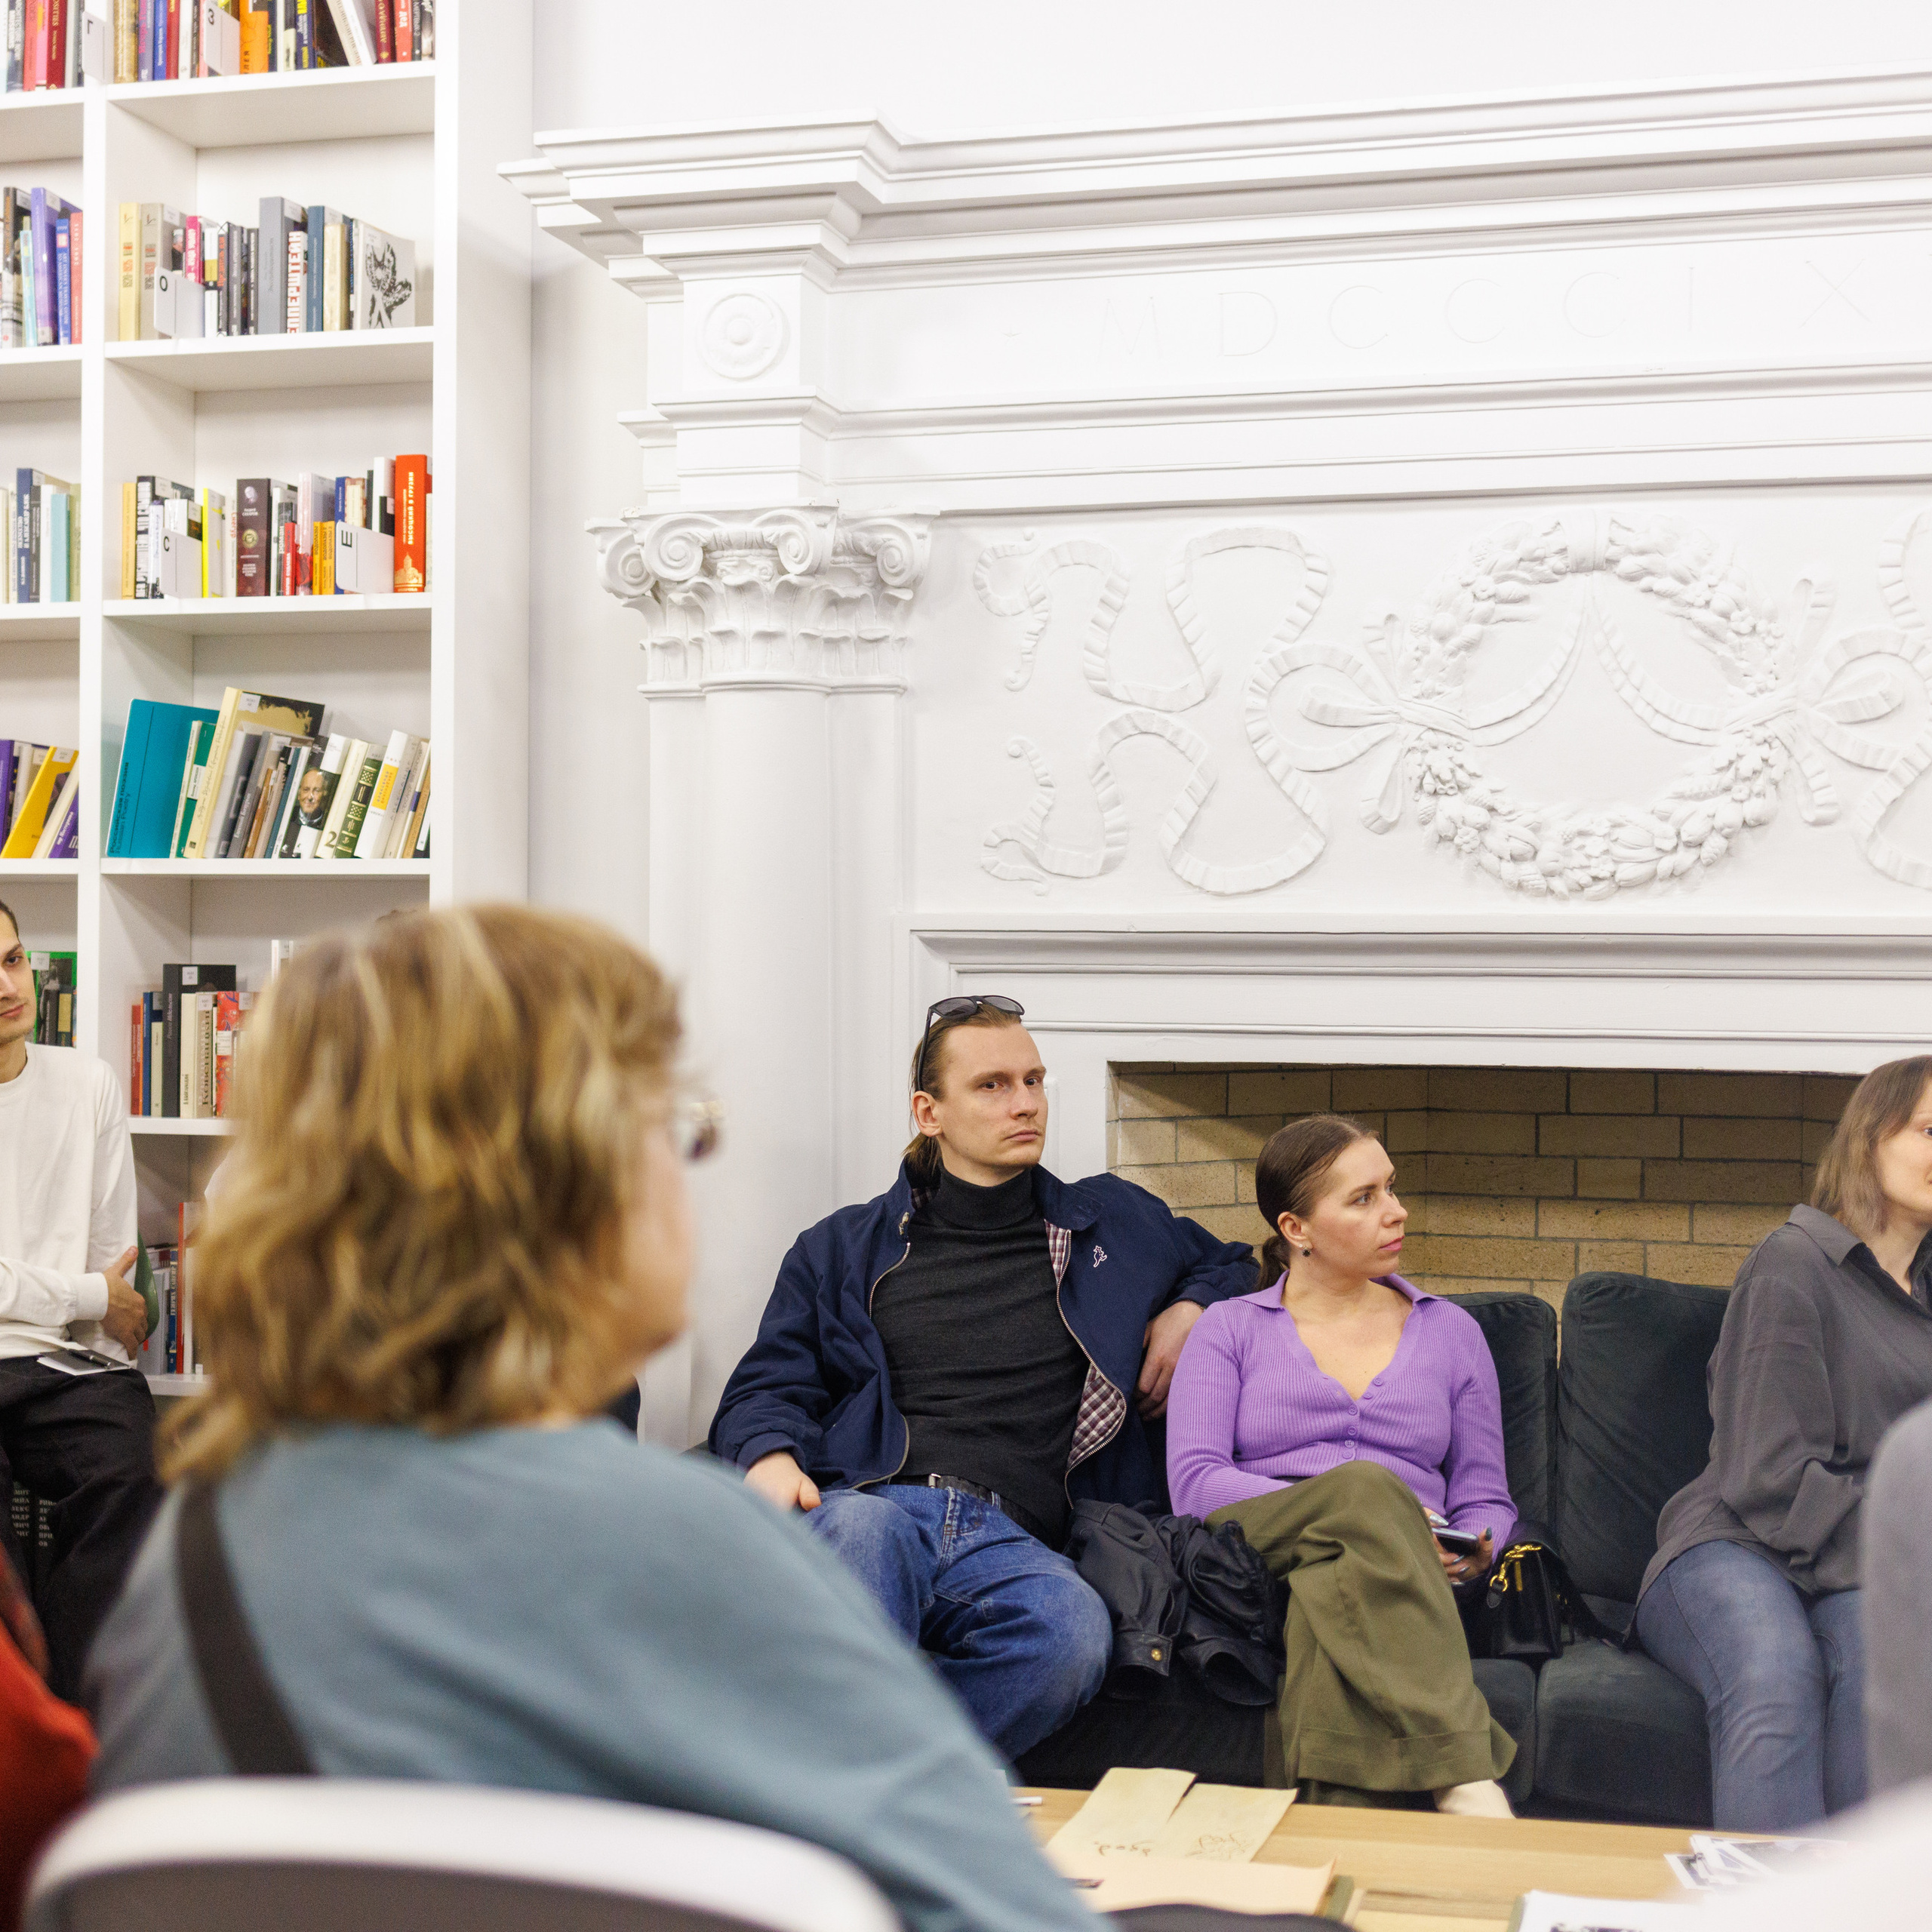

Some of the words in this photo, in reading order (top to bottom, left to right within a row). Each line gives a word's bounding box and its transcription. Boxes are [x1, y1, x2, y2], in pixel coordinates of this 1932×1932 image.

[109, 797, 124, 854] Российская
[119, 761, 129, 796] поэзия
[115, 820, 125, 854] Russian
[121, 792, 131, 820] Poetry
[324, 831, 337, 848] 2
